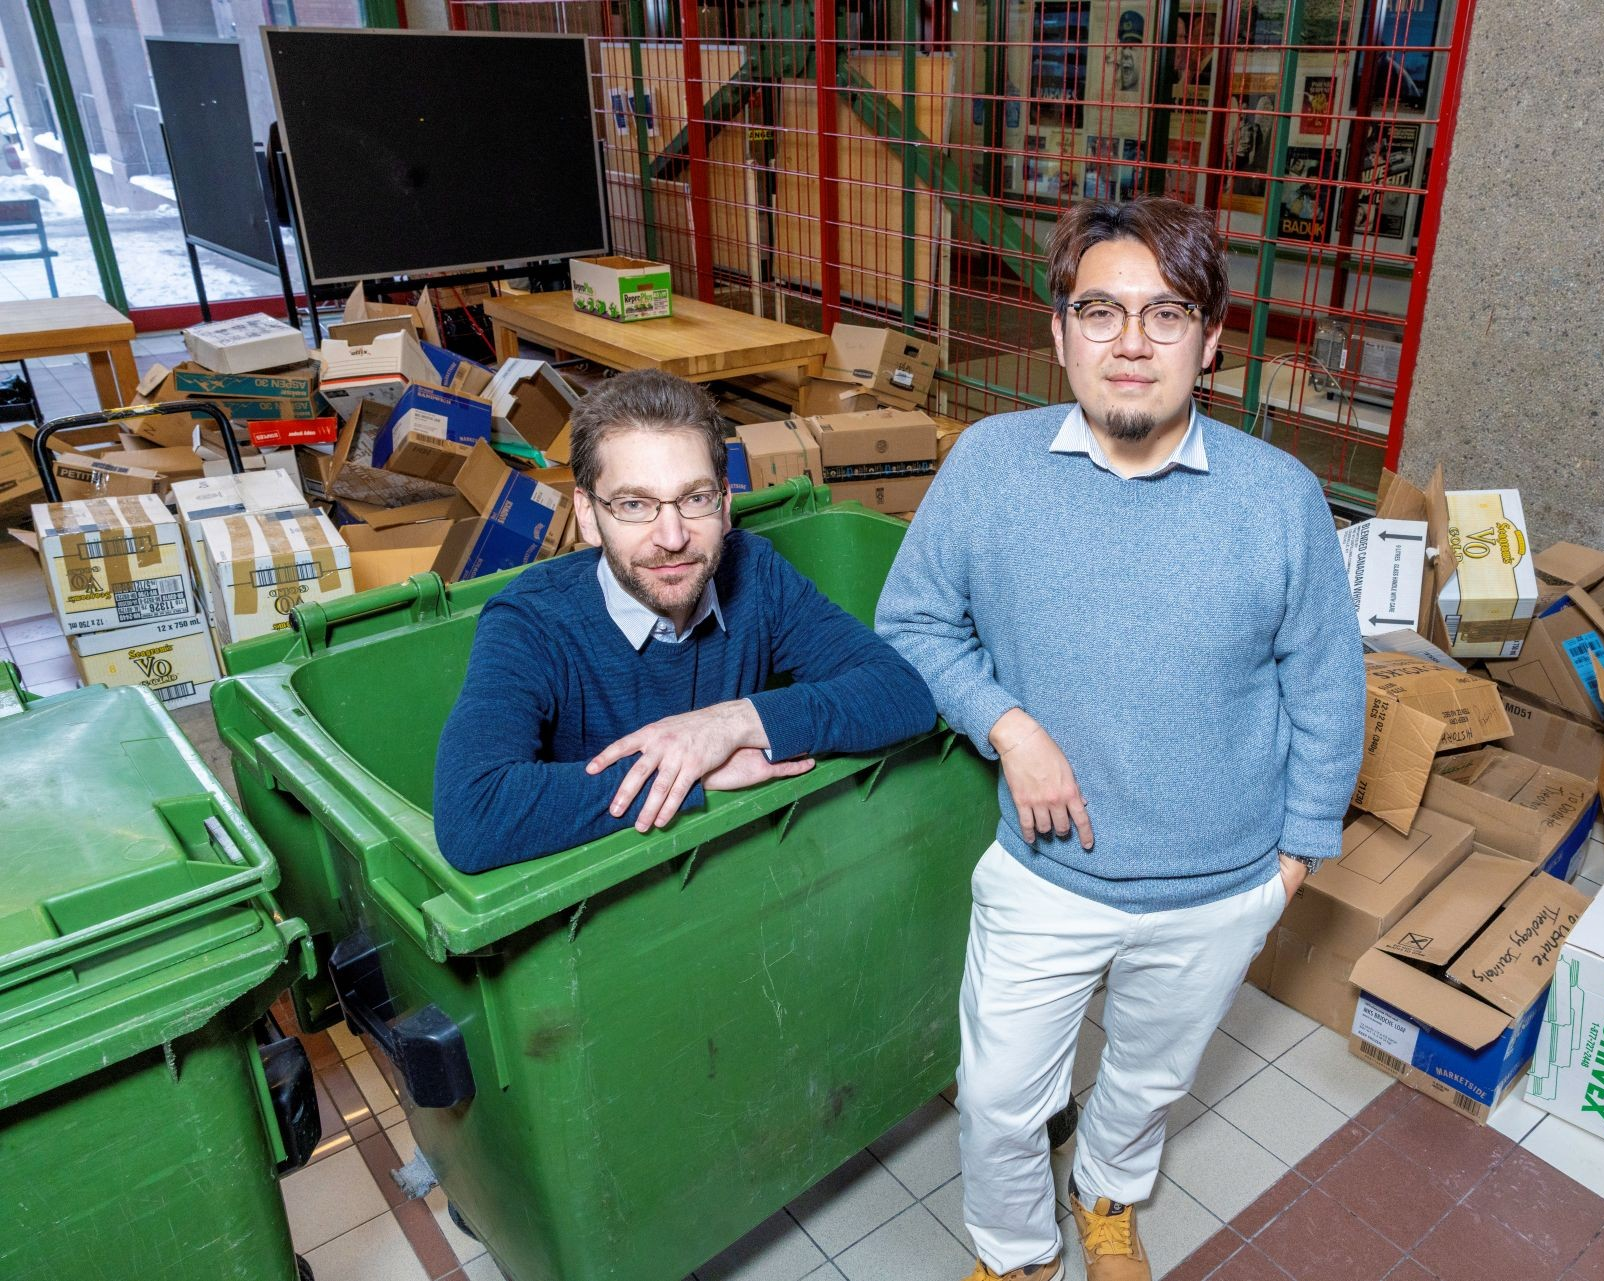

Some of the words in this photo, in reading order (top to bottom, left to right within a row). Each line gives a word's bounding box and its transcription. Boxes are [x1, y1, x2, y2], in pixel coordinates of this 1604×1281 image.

[1282, 218, 1325, 237] BADUK
[254, 378, 268, 387] 30
[271, 379, 306, 389] ASPEN
[1358, 523, 1371, 551] BLENDED
[1463, 527, 1496, 559] VO
[1496, 522, 1515, 565] Seagram's
[1354, 552, 1366, 588] CANADIAN
[149, 601, 175, 612] 11326
[79, 621, 91, 629] 750
[157, 625, 167, 633] 12
[174, 621, 189, 630] 750
[134, 656, 172, 678] VO
[1370, 698, 1380, 719] SACS
[1378, 702, 1389, 722] 12-12
[1505, 703, 1532, 720] MD51
[1374, 722, 1384, 733] OZ
[1367, 732, 1381, 756] (340g)
[1355, 780, 1368, 805] 71730
[1569, 791, 1585, 806] To
[1516, 905, 1561, 947] Theology
[1435, 1067, 1488, 1100] MARKETSIDE
